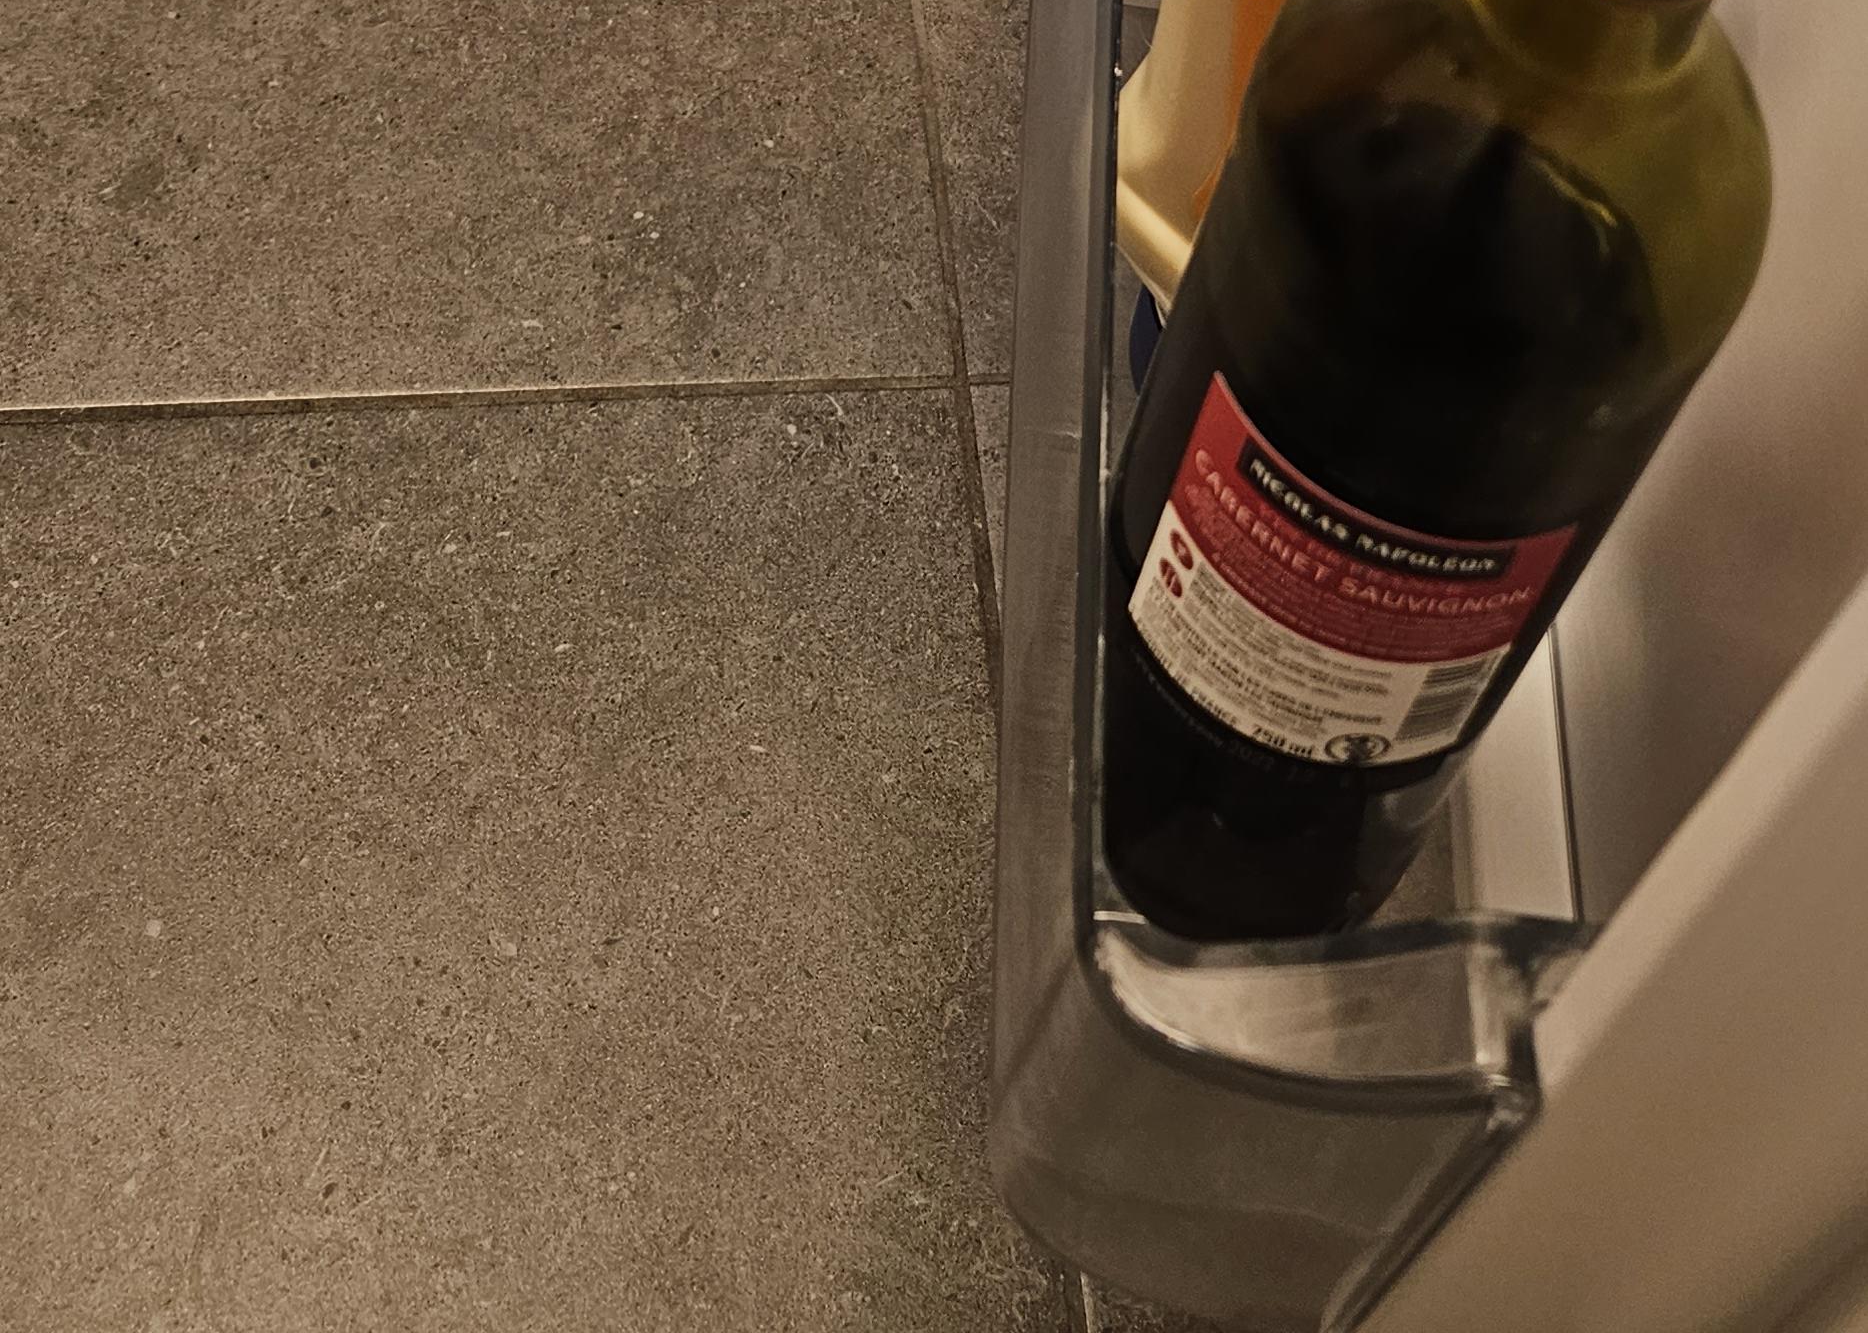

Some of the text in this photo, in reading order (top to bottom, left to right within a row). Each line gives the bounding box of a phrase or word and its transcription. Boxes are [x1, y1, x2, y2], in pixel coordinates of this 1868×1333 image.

[1195, 448, 1332, 581] CABERNET
[1340, 576, 1536, 614] SAUVIGNON
[1250, 458, 1349, 541] NICOLAS
